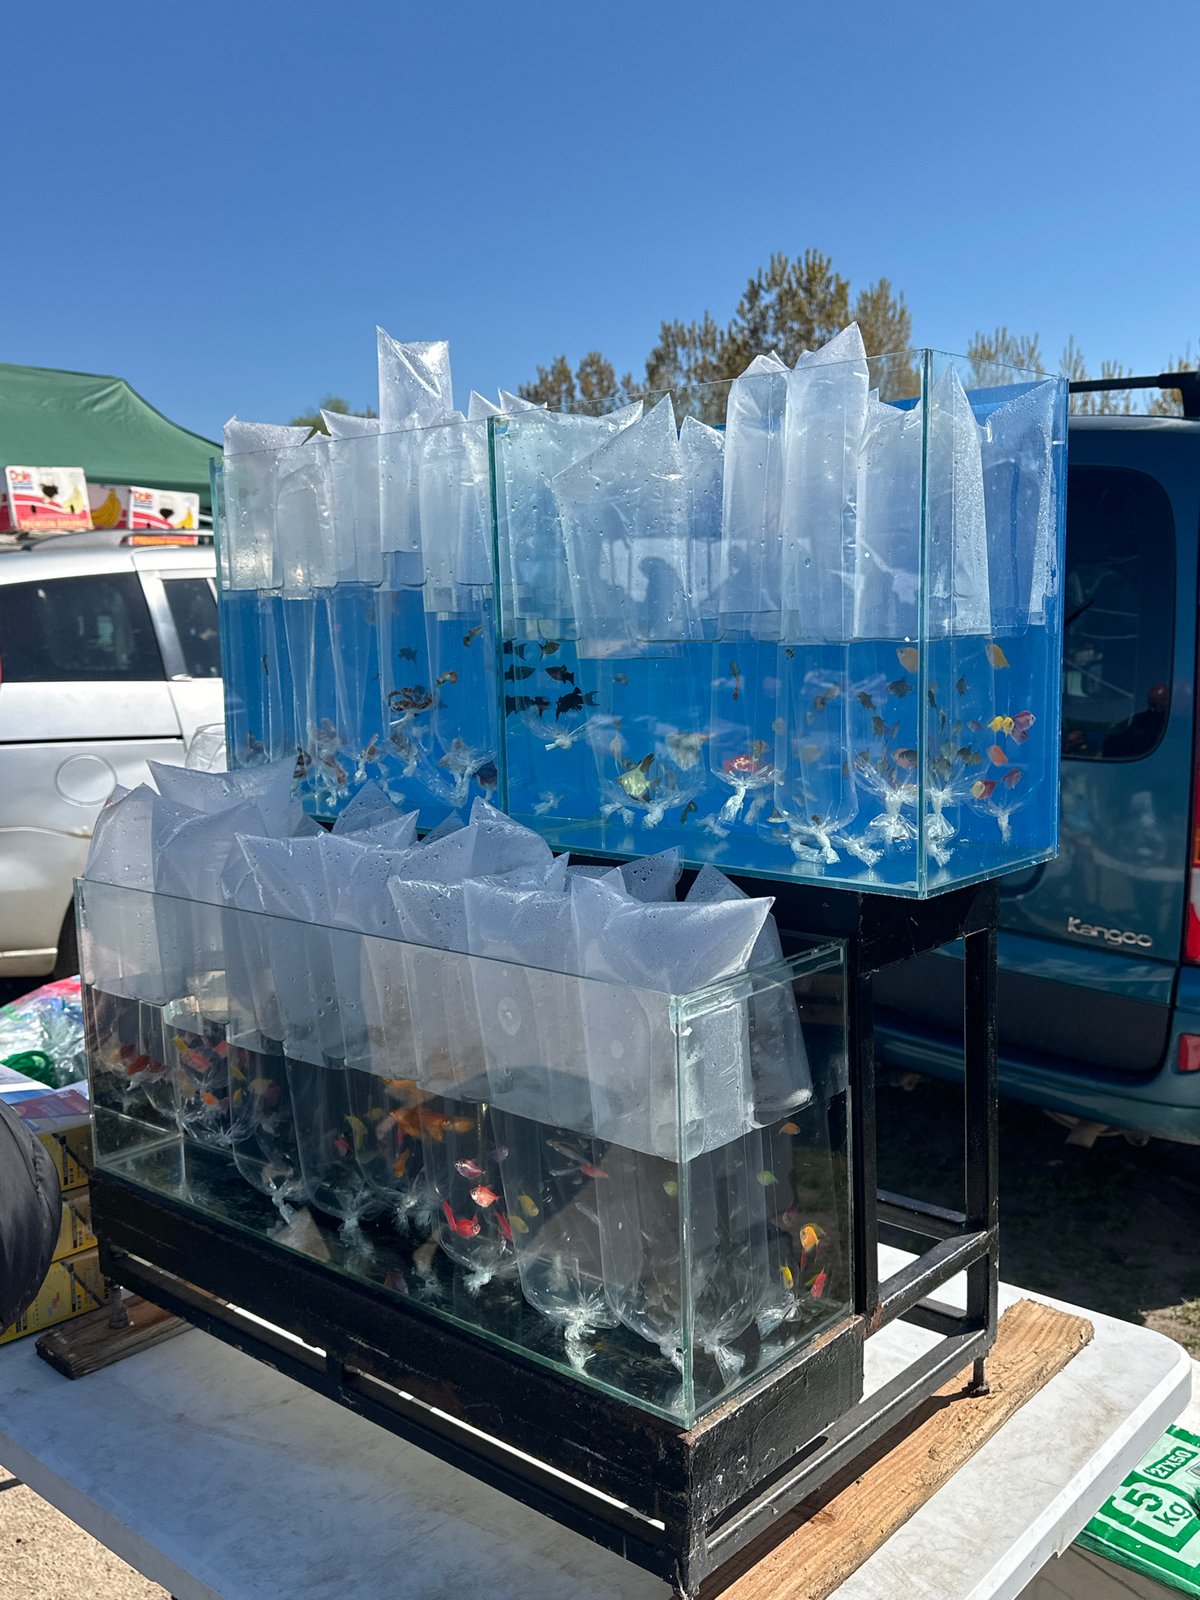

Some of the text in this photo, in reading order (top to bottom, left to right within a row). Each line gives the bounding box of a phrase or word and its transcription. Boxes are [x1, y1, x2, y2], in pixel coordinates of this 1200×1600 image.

[10, 471, 31, 482] Dole
[134, 490, 153, 502] Dole
[1067, 916, 1153, 947] Kangoo
[1123, 1488, 1163, 1512] 5
[1152, 1501, 1193, 1528] kg
